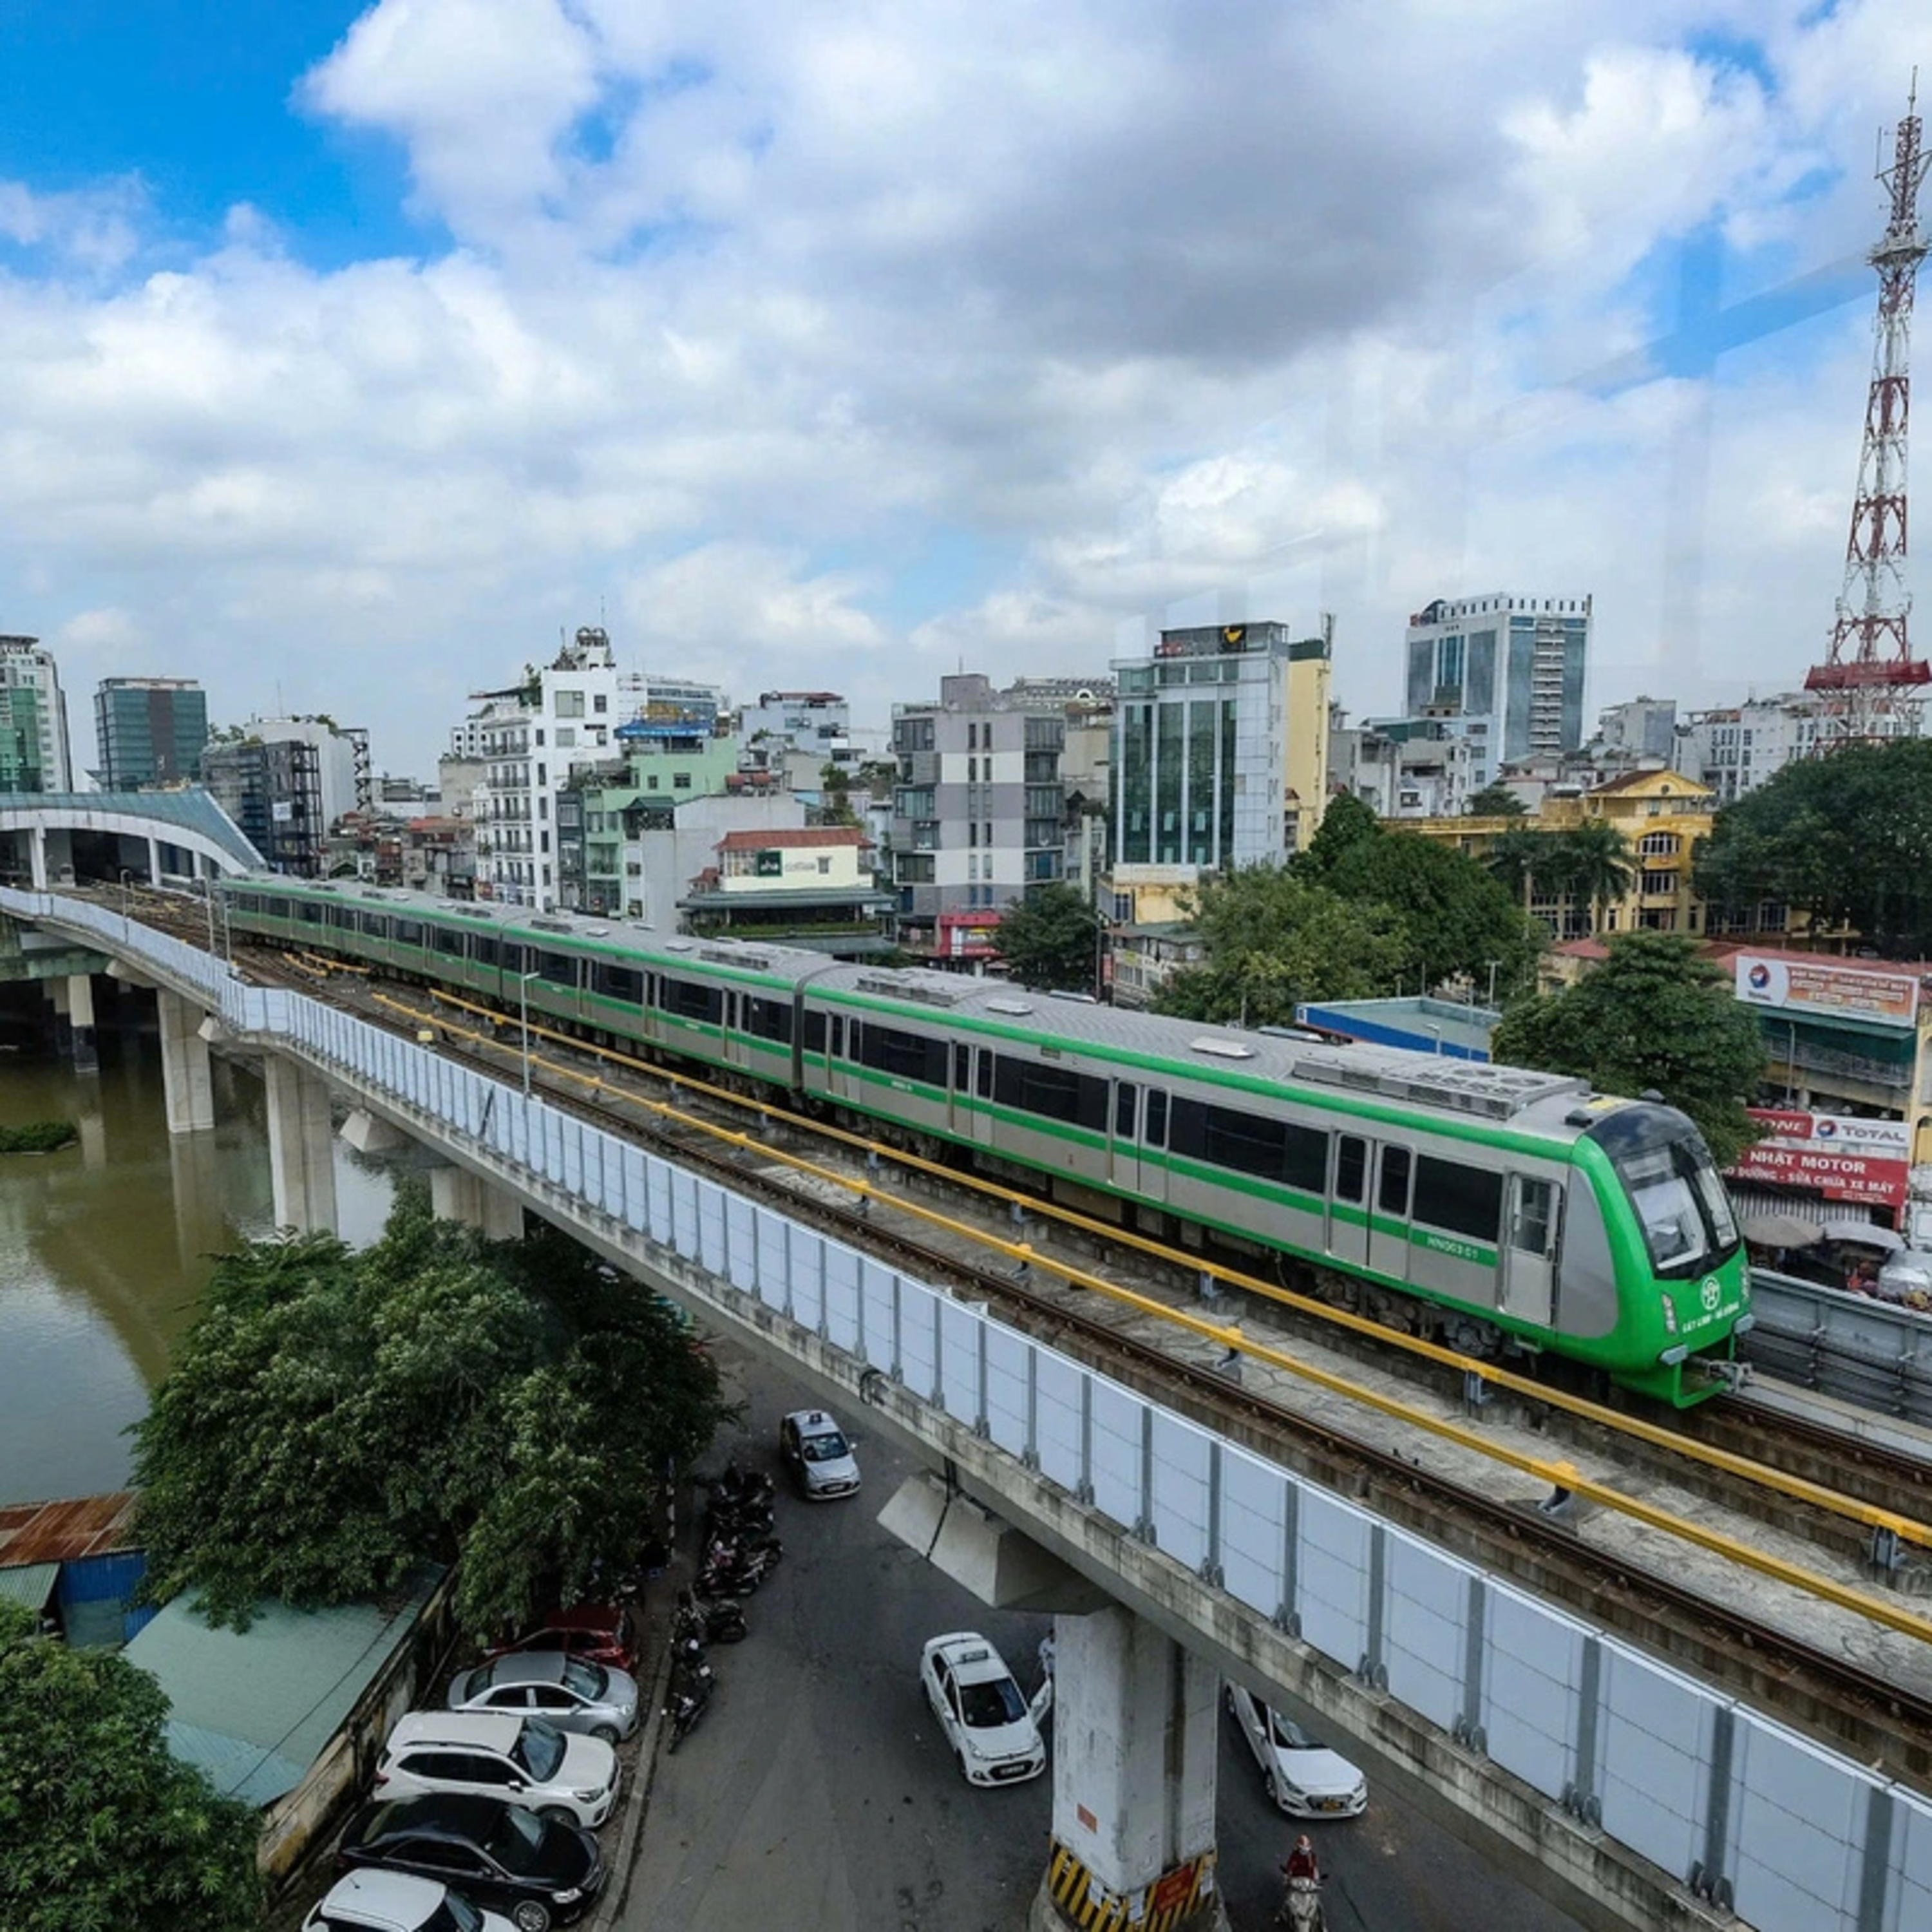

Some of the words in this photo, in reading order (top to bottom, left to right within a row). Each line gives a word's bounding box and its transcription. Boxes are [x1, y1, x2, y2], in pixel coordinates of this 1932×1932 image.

[1842, 1124, 1906, 1143] TOTAL
[1750, 1150, 1795, 1167] NHẬT
[1801, 1156, 1866, 1174] MOTOR
[1850, 1179, 1864, 1191] XE
[1868, 1180, 1895, 1194] MÁY
